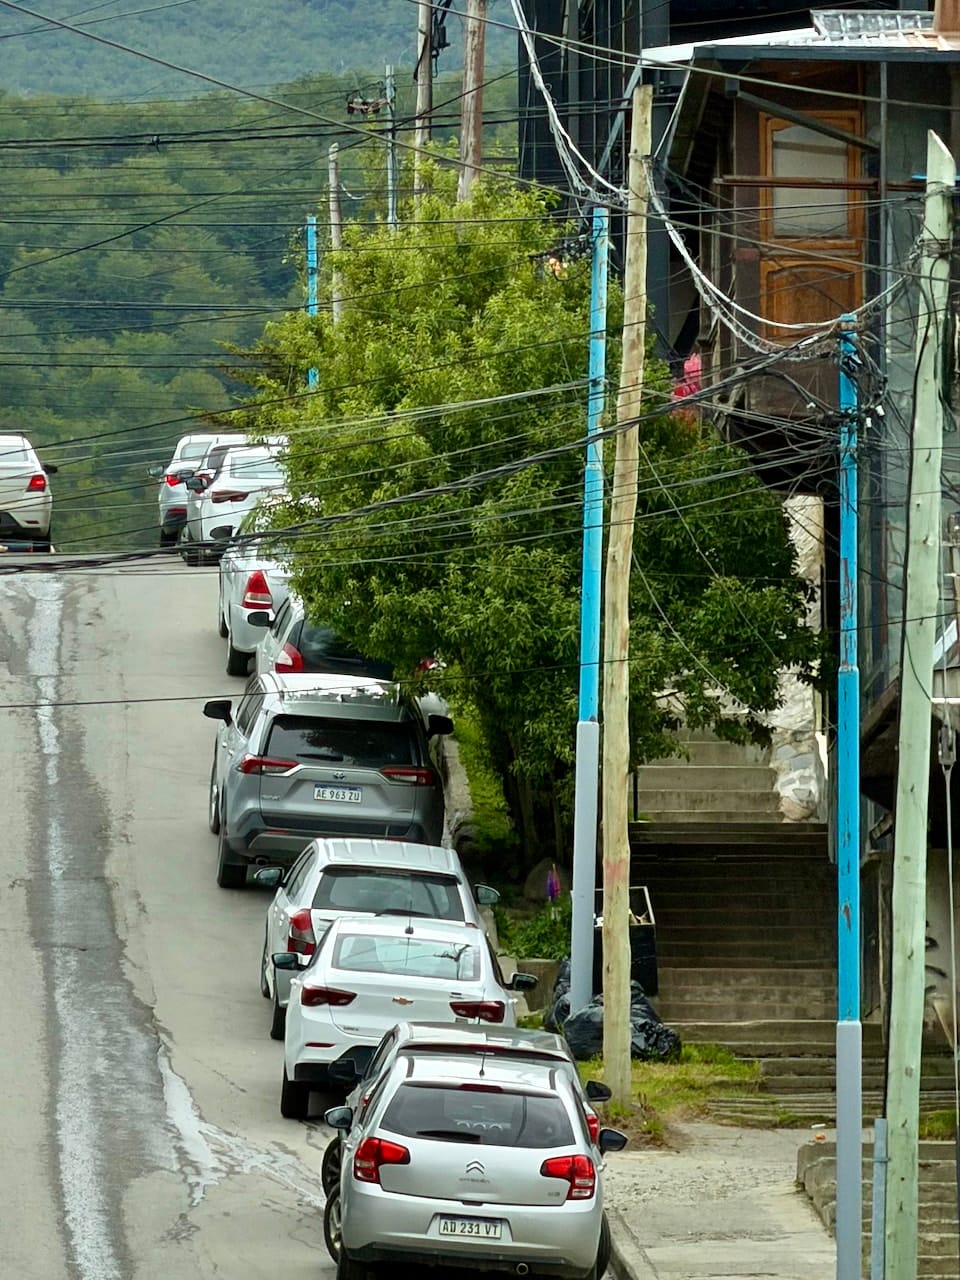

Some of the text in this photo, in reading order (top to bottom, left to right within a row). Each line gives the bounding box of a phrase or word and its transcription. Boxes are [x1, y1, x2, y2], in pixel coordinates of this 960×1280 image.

[316, 789, 326, 798] AE
[329, 790, 346, 800] 963
[442, 1220, 499, 1236] AD 231 VT
